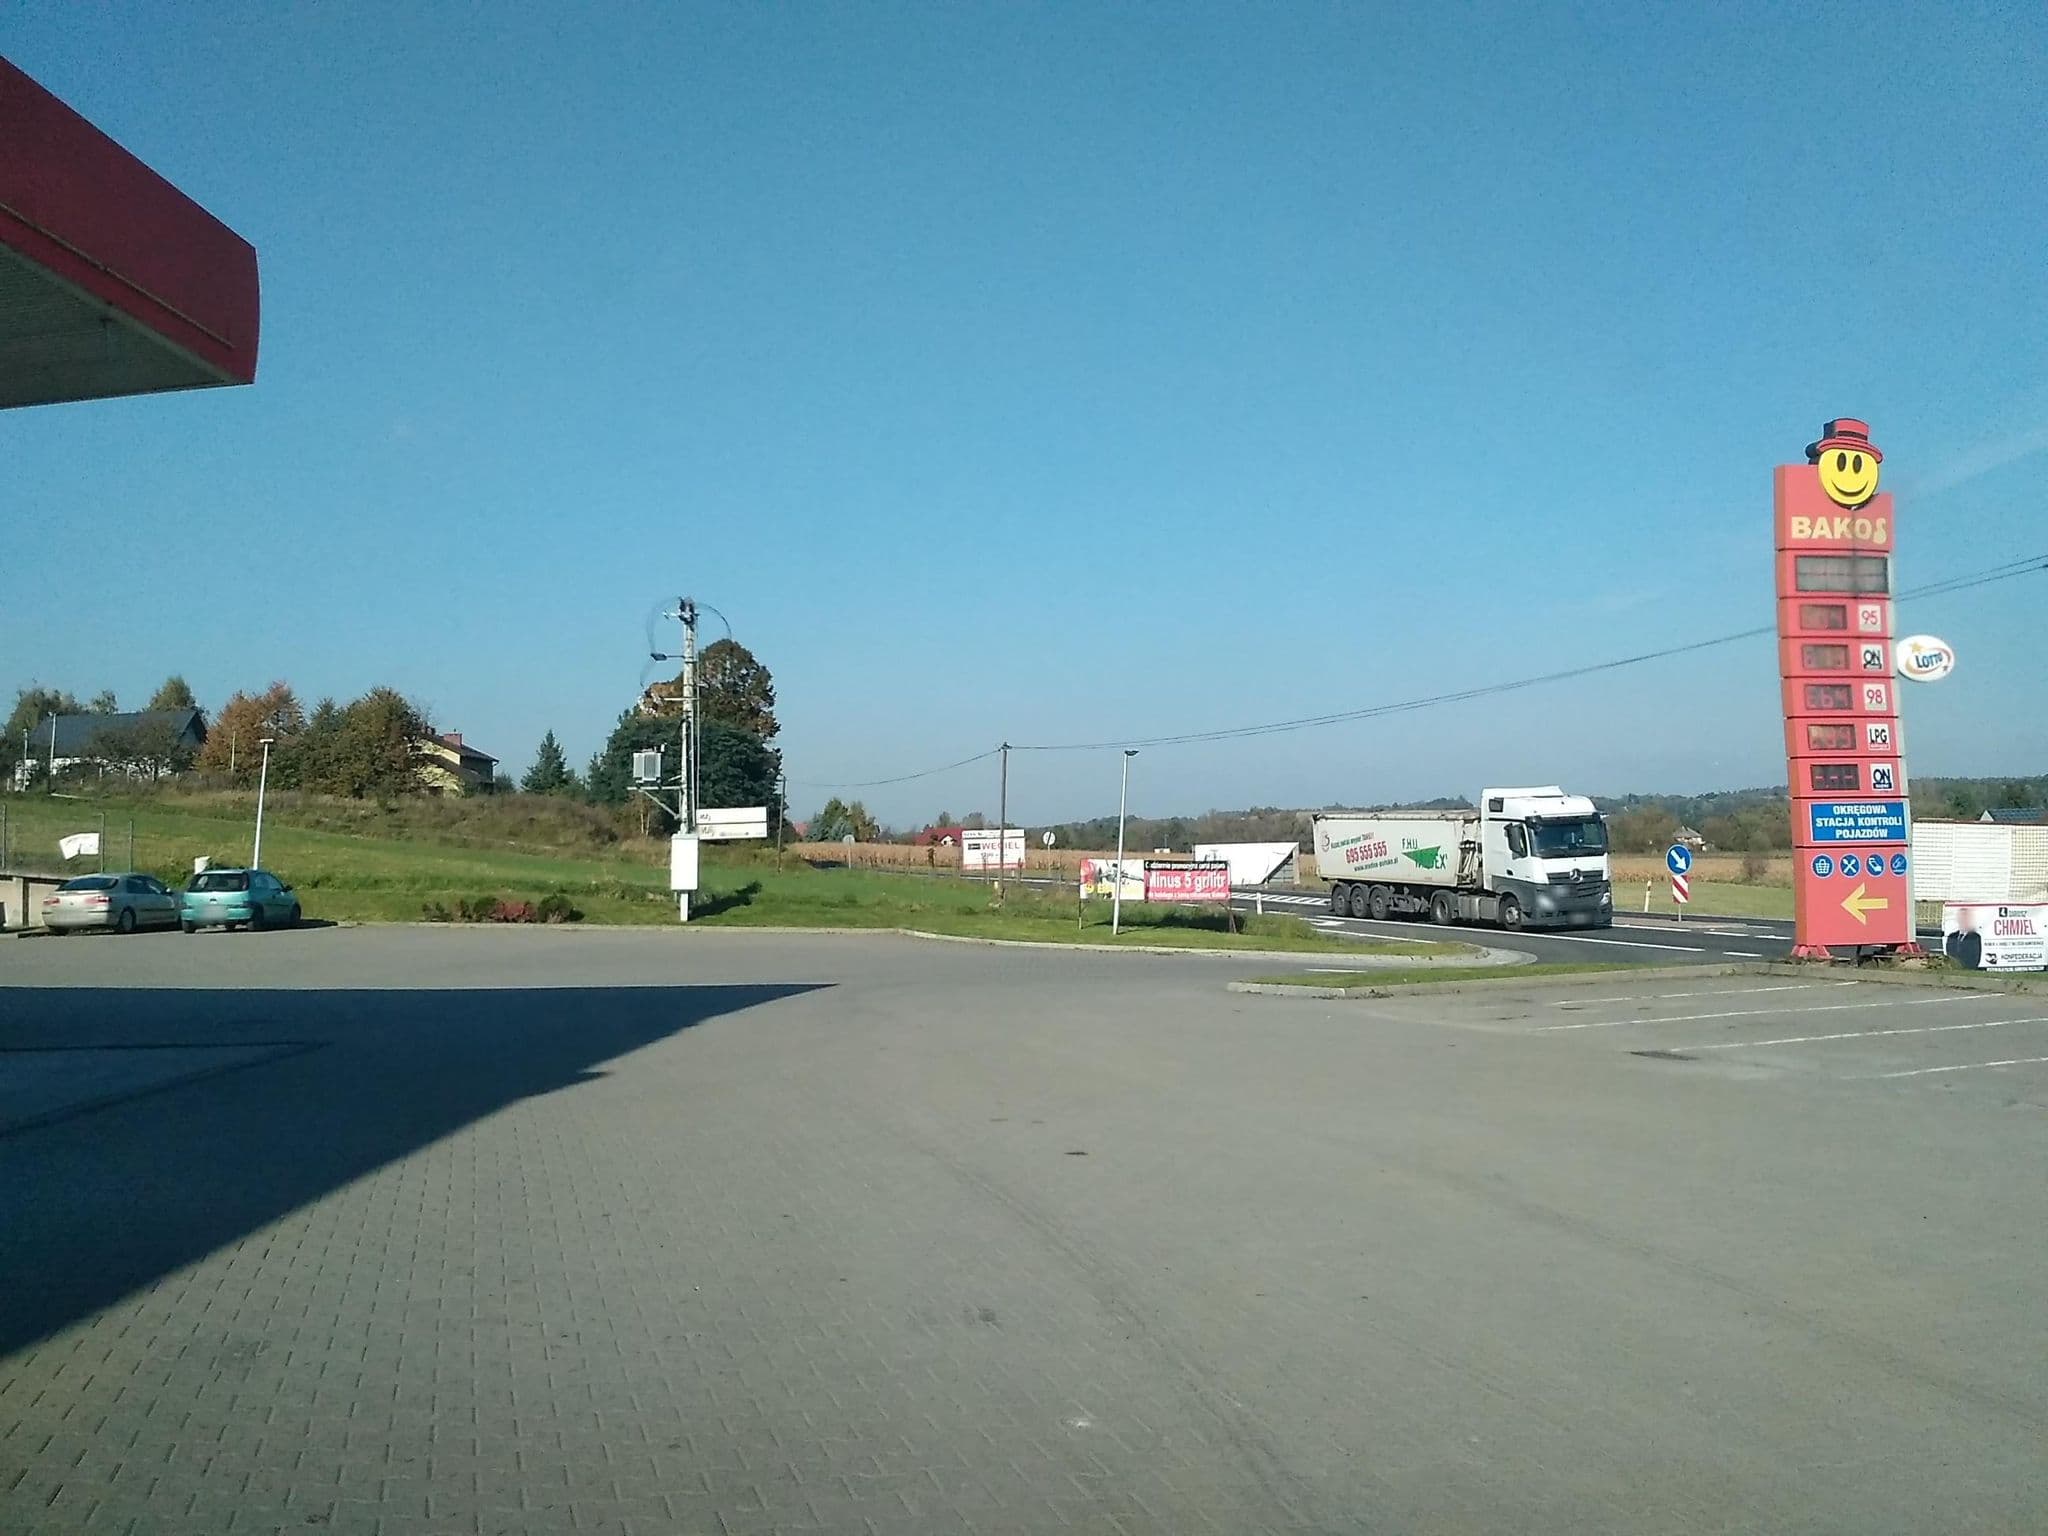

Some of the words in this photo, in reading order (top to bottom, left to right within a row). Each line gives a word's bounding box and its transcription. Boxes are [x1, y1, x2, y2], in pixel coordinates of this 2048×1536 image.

[1861, 610, 1878, 625] 95
[1863, 649, 1881, 665] ON
[1915, 652, 1943, 668] LOTTO
[1866, 689, 1883, 704] 98
[1869, 728, 1888, 743] LPG
[1873, 768, 1891, 784] ON
[1832, 805, 1887, 816] OKRĘGOWA
[1815, 817, 1855, 828] STACJA
[1858, 816, 1903, 826] KONTROLI
[1835, 828, 1888, 839] POJAZDÓW
[1345, 847, 1359, 864] 695
[1359, 844, 1373, 861] 555
[1373, 841, 1388, 858] 555
[1184, 871, 1192, 888] 5
[1993, 919, 2037, 936] CHMIEL
